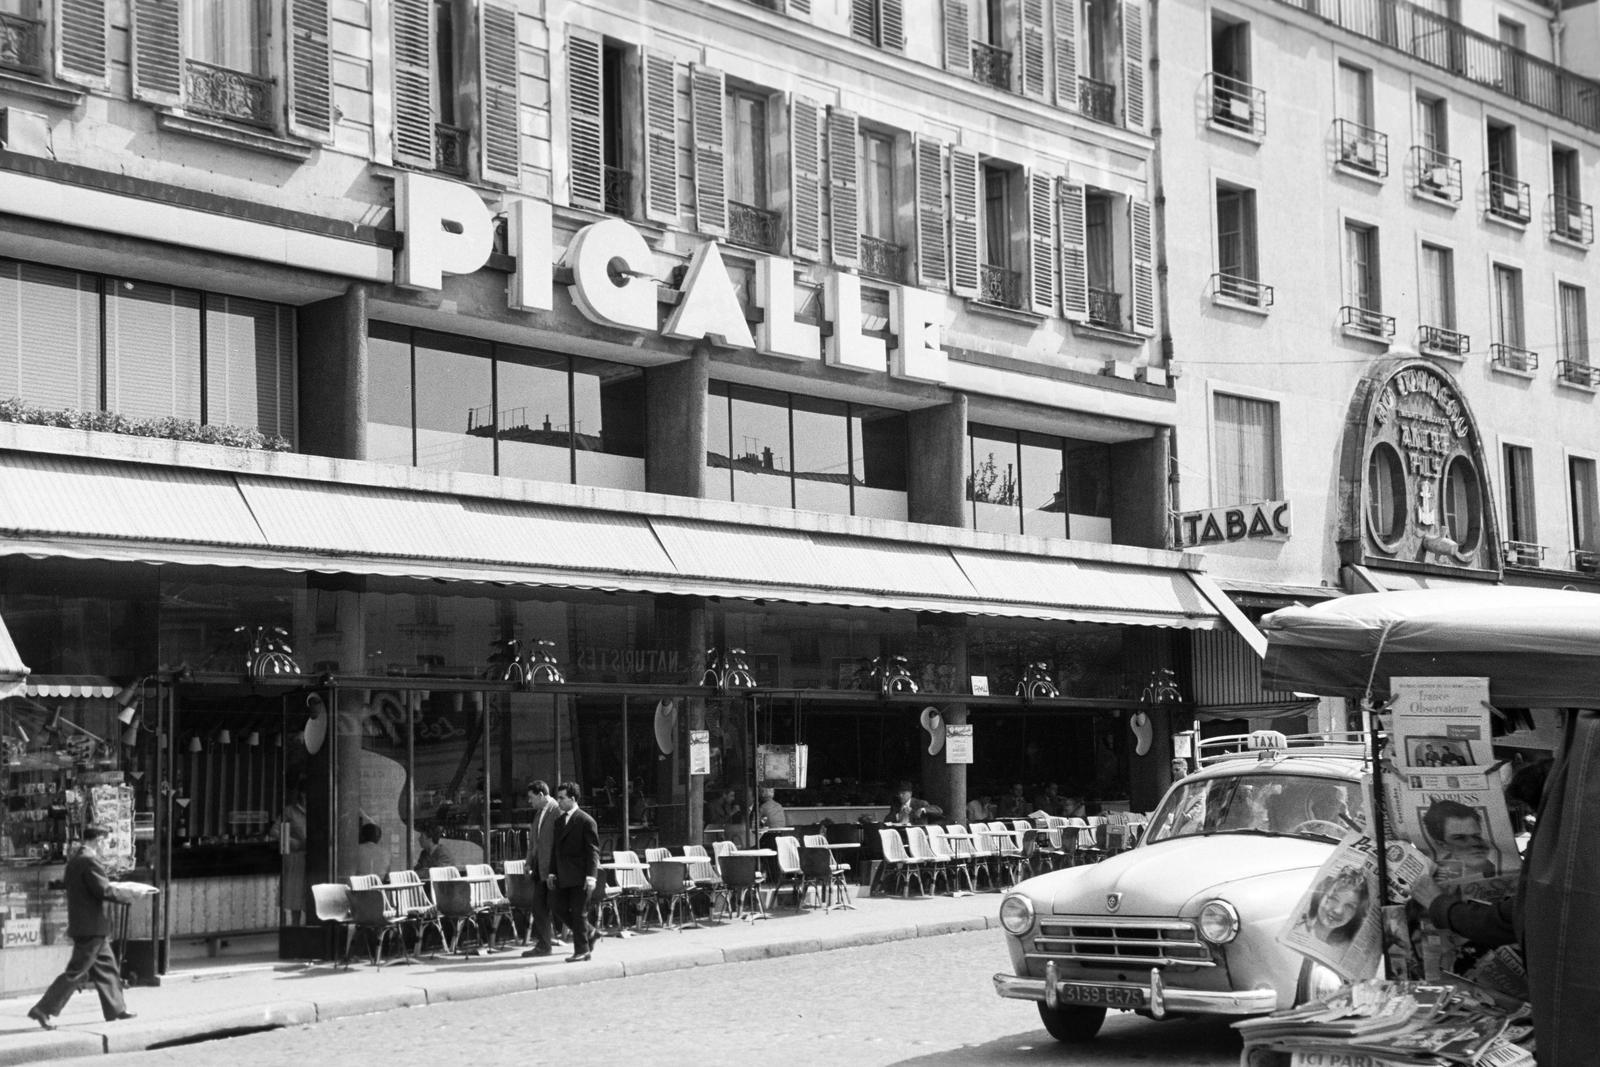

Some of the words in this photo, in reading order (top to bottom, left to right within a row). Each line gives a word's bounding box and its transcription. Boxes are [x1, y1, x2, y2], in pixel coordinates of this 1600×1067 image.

[394, 171, 950, 385] PIGALLE
[1183, 502, 1289, 544] TABAC
[1409, 702, 1470, 714] Observateur
[1252, 735, 1280, 748] TAXI
[6, 931, 38, 944] PMU
[1300, 1053, 1324, 1067] ICI
